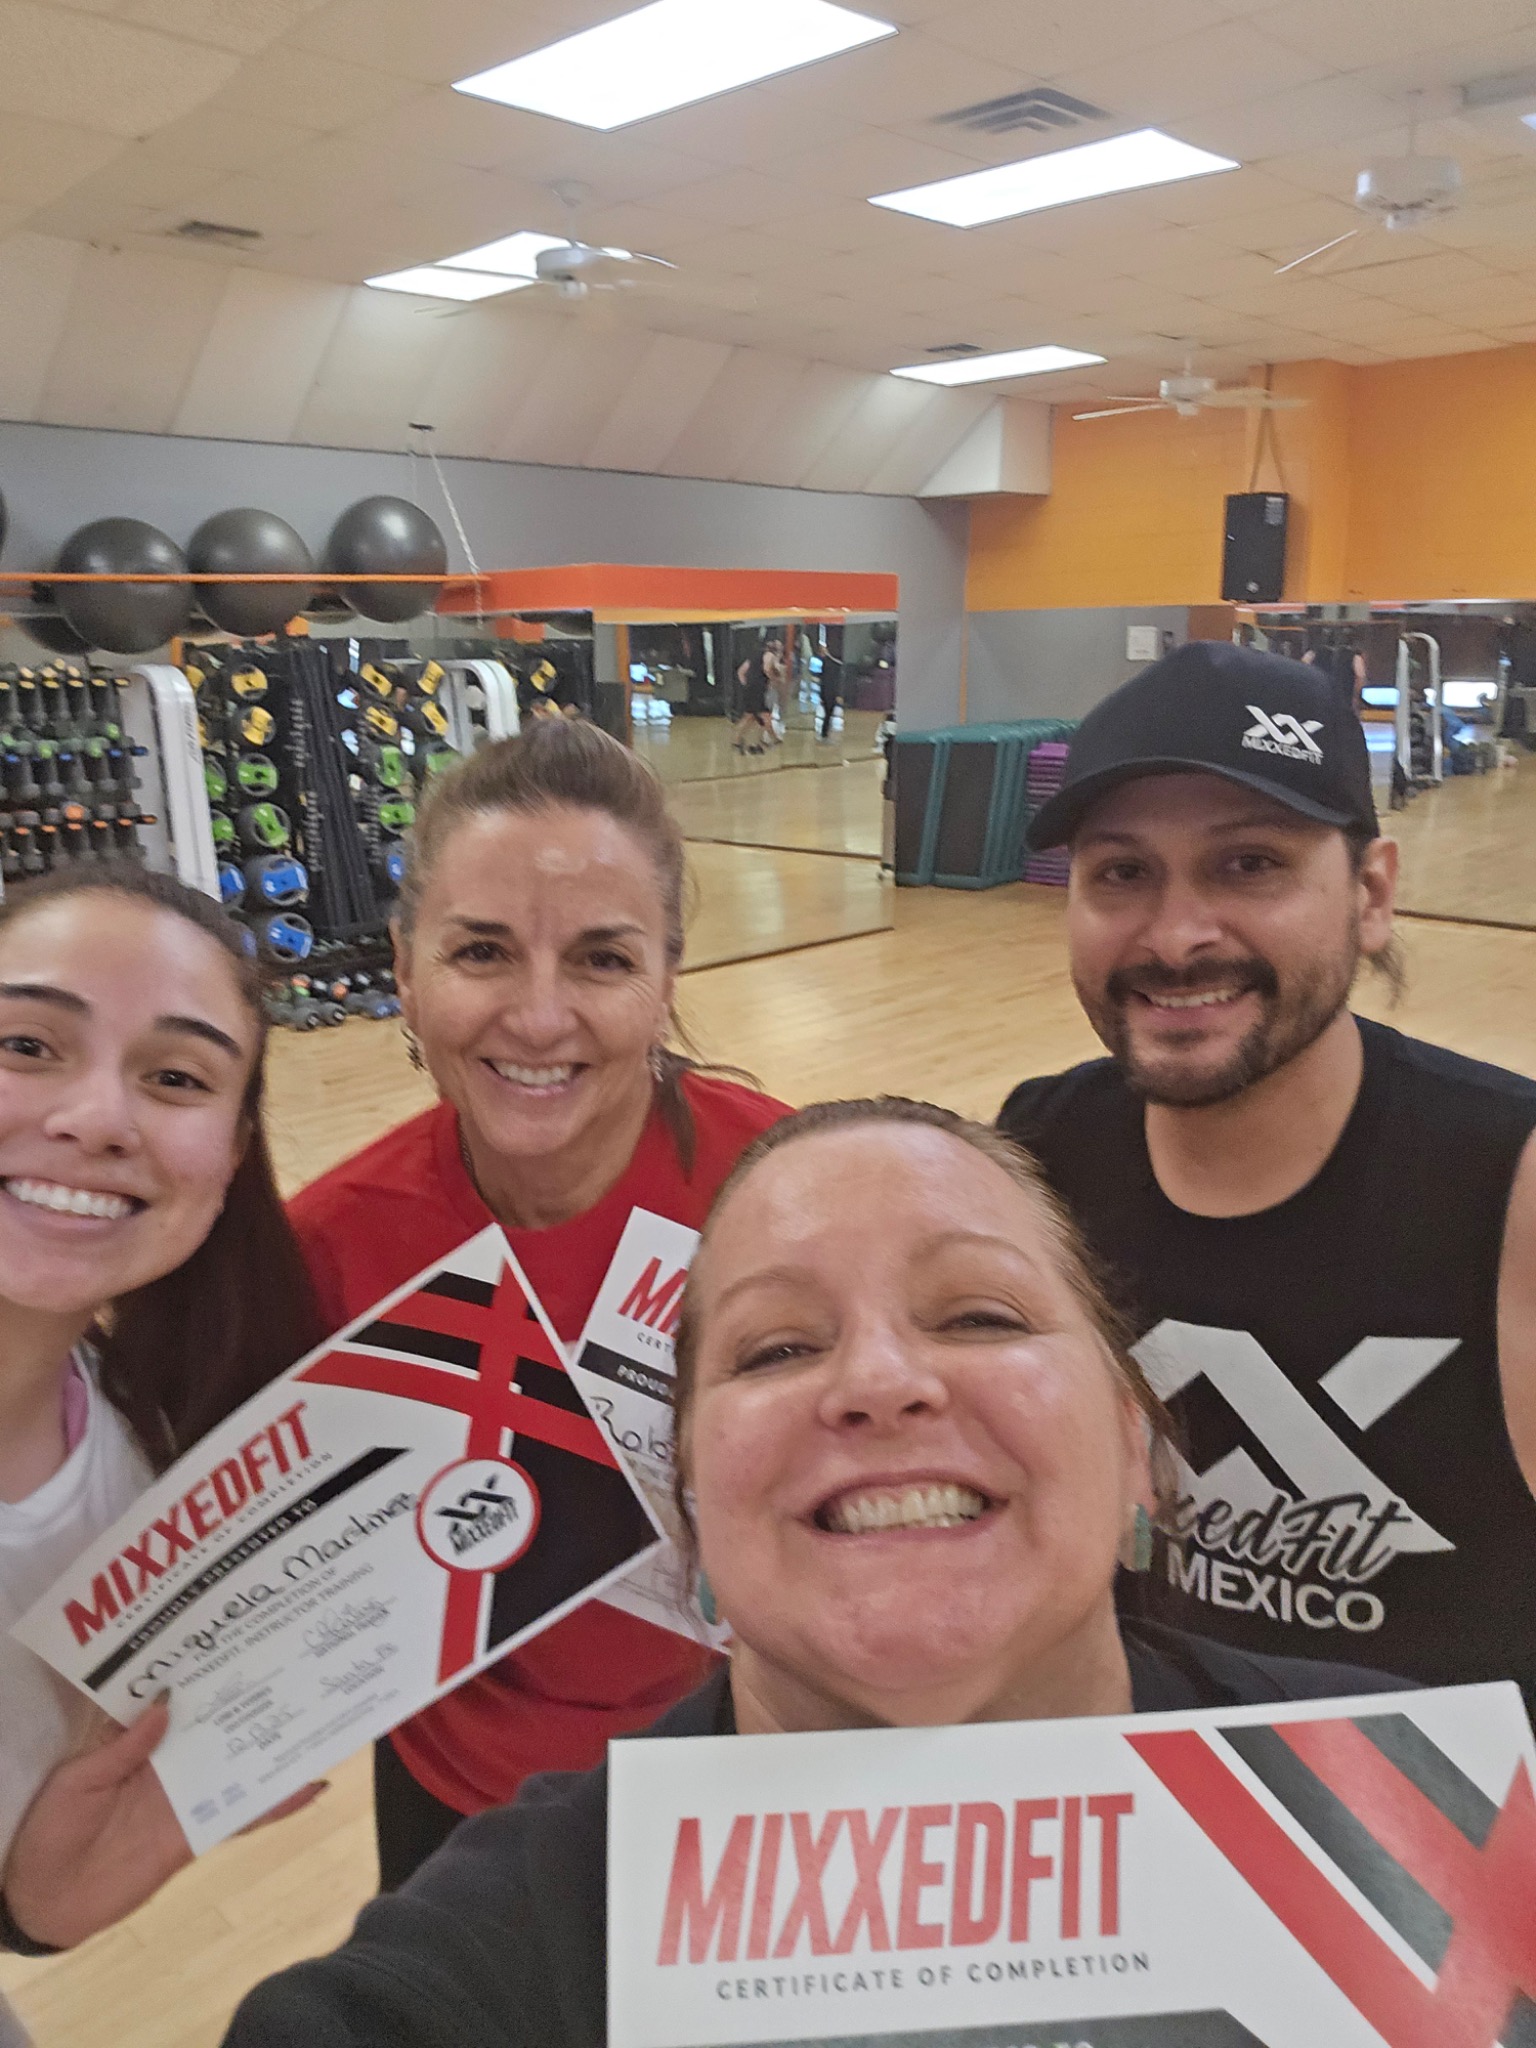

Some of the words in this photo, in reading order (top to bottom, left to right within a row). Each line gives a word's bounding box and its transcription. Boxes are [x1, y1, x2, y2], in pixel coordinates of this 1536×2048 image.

[63, 1400, 312, 1646] MIXXEDFIT
[1168, 1544, 1385, 1632] MEXICO
[656, 1793, 1135, 1967] MIXXEDFIT
[716, 1968, 905, 2001] CERTIFICATE
[918, 1964, 954, 1988] OF
[966, 1951, 1152, 1986] COMPLETION
